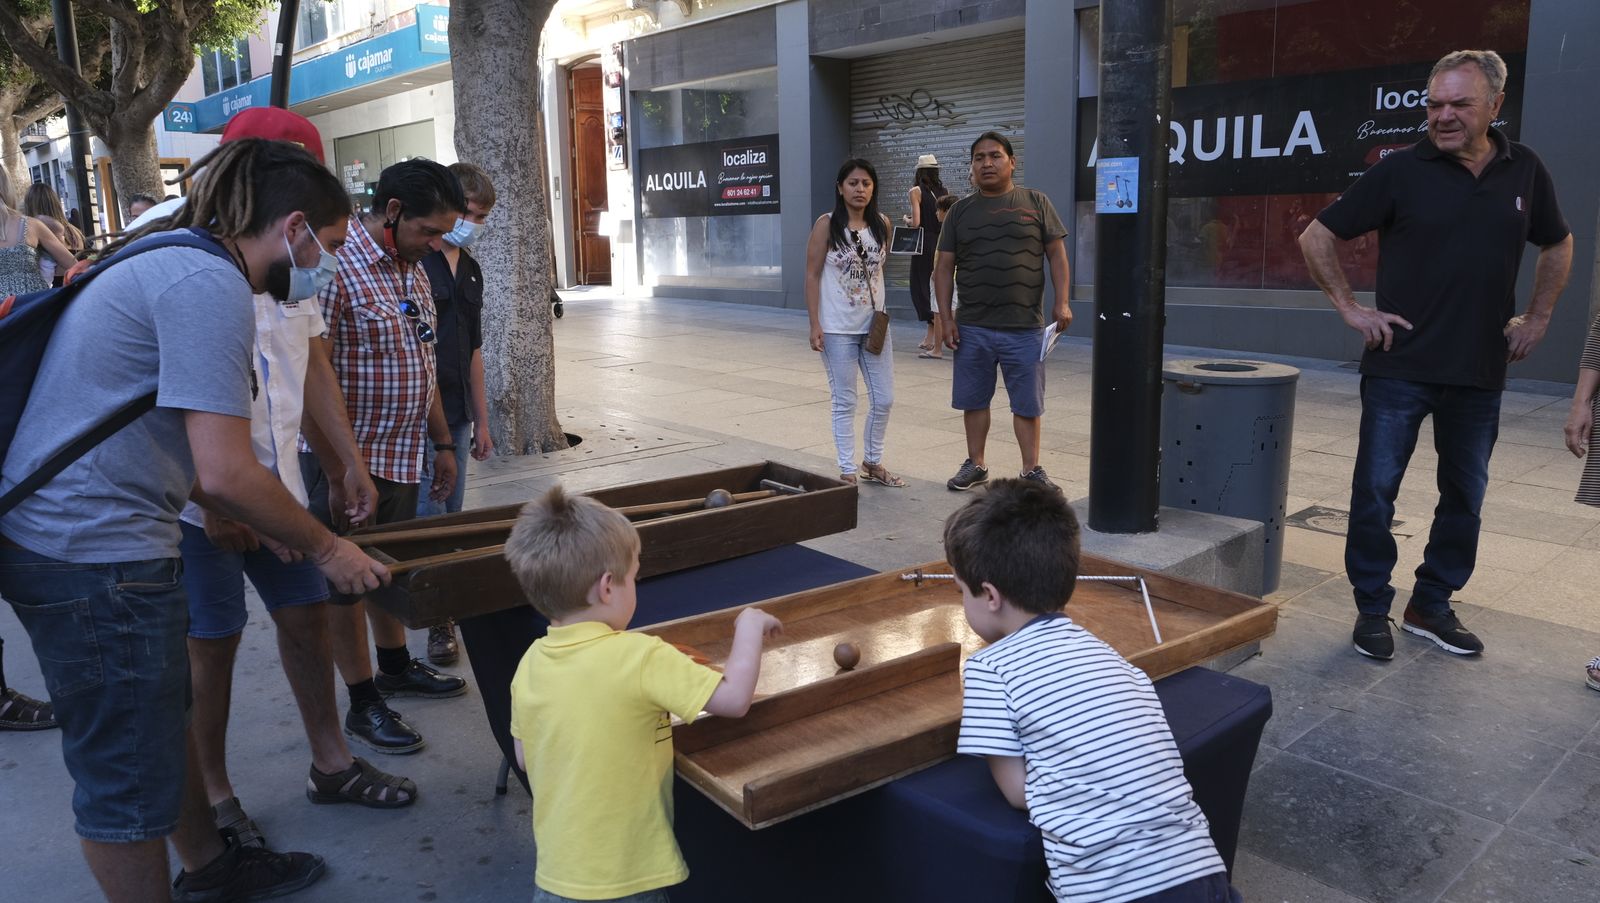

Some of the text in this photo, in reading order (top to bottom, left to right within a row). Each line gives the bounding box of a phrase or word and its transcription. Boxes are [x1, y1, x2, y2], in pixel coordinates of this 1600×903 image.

[424, 32, 449, 44] cajam
[357, 47, 393, 74] cajamar
[1375, 87, 1429, 111] loca
[1357, 120, 1415, 140] Buscamos
[723, 150, 766, 166] localiza
[646, 170, 707, 191] ALQUILA
